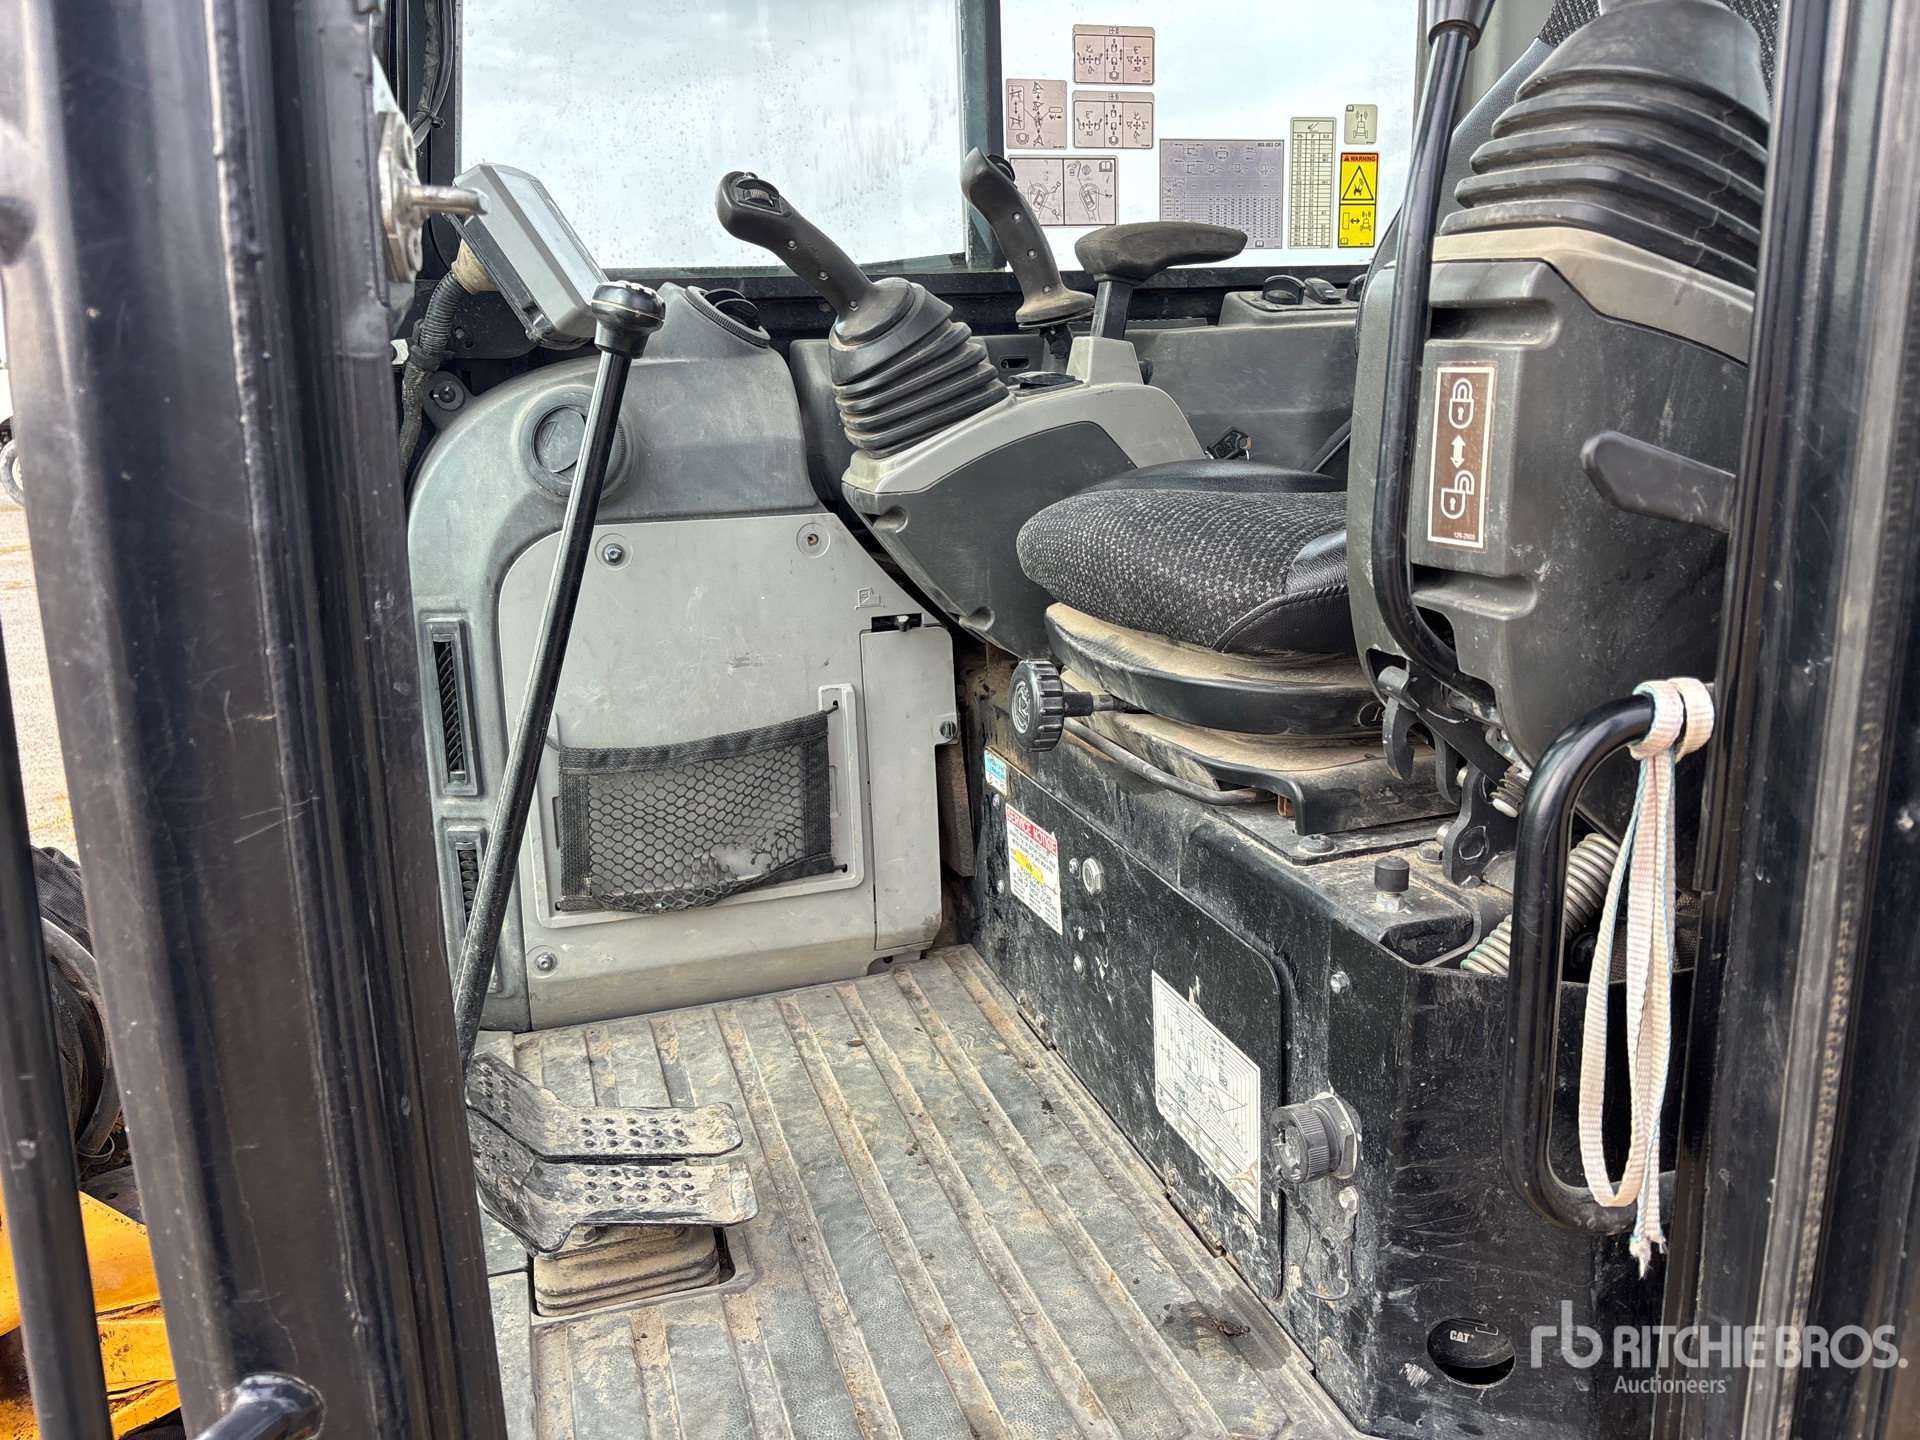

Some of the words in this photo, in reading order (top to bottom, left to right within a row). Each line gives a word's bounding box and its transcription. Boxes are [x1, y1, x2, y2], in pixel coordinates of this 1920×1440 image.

[1007, 809, 1033, 835] SERVICE
[1033, 826, 1057, 855] NOTICE
[1449, 1330, 1471, 1343] CAT
